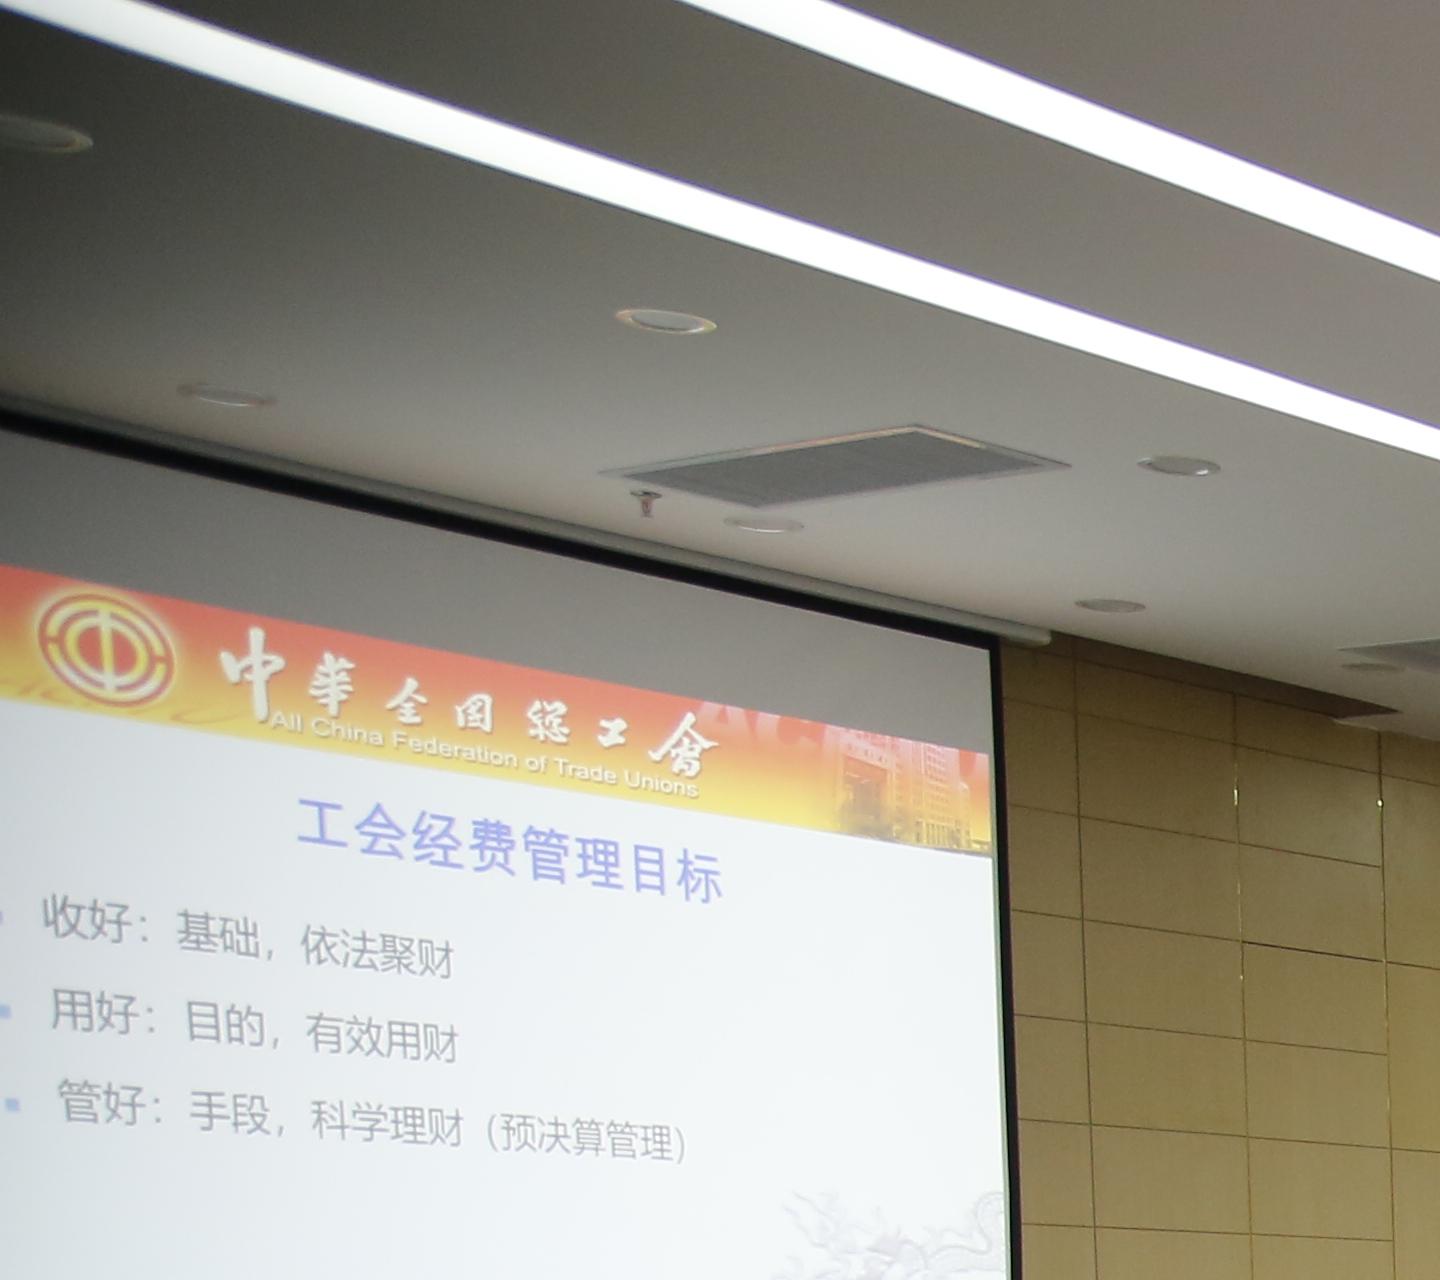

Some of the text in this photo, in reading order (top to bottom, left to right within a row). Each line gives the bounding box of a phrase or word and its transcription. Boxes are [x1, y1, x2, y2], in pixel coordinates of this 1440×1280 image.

[270, 711, 699, 798] All China Federation of Trade Unions
[298, 797, 723, 904] 工会经费管理目标
